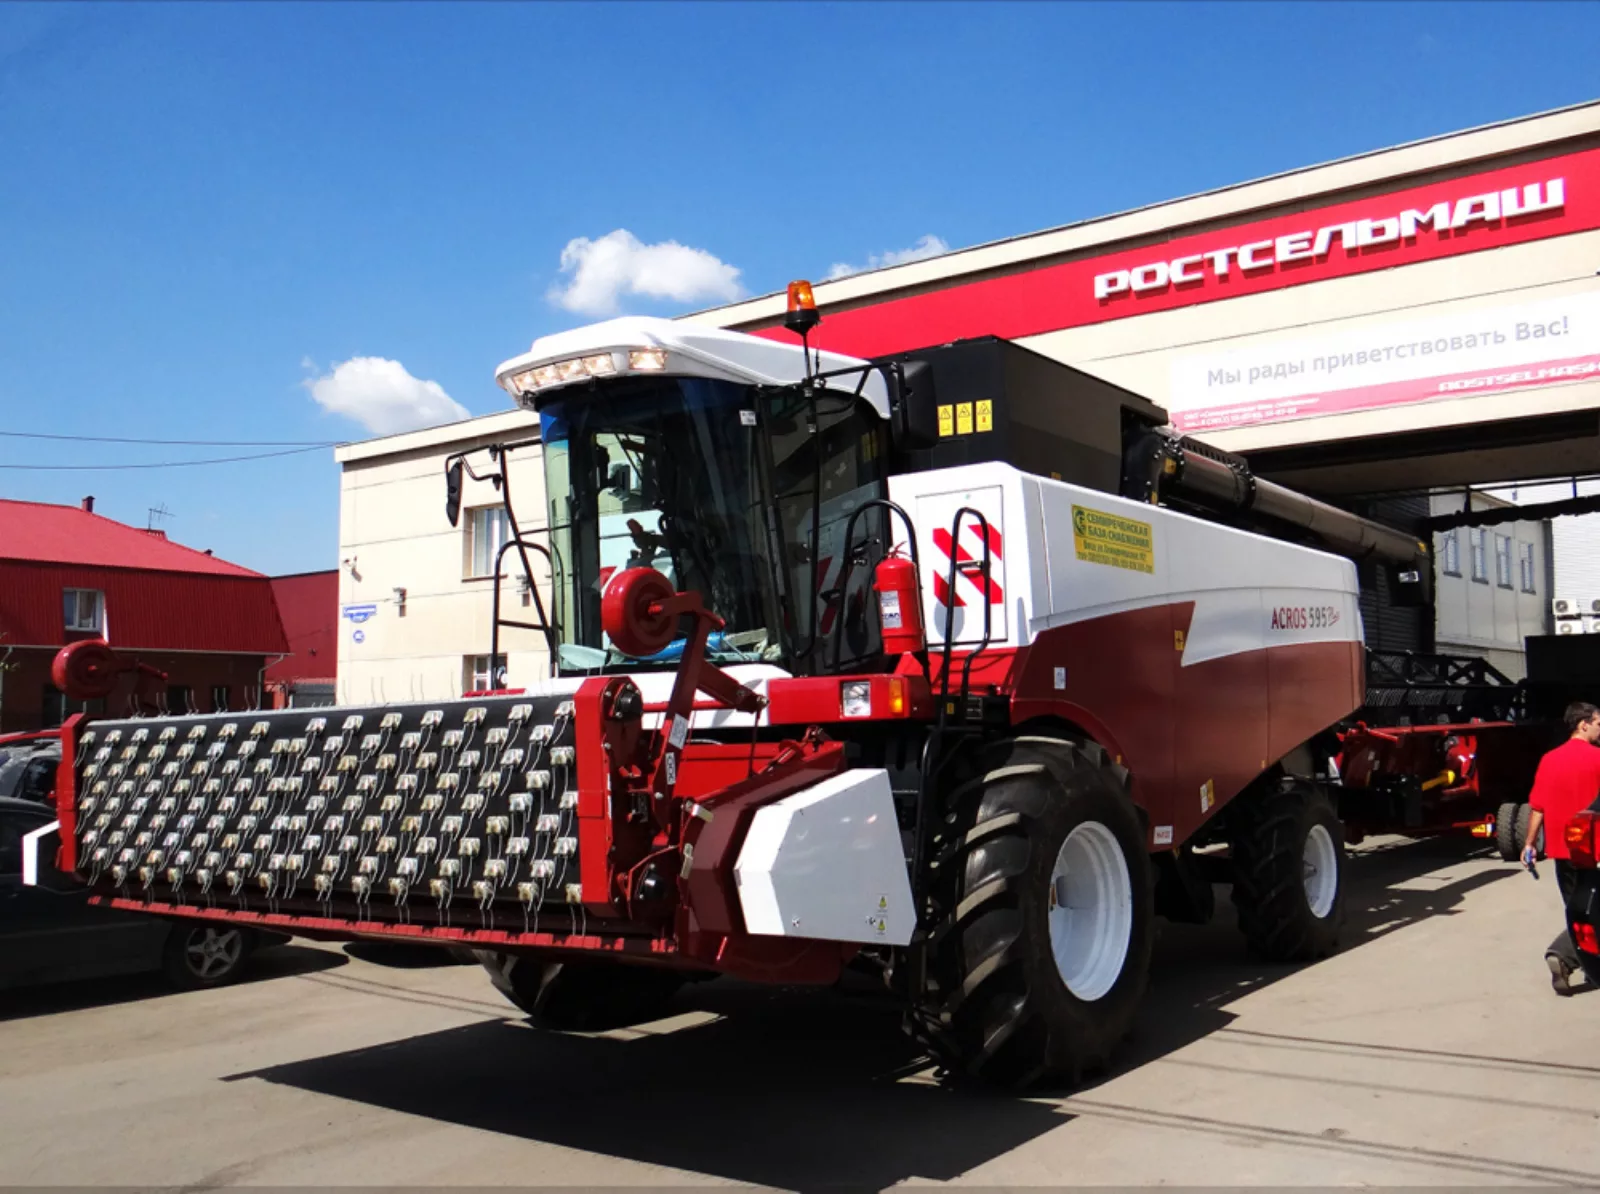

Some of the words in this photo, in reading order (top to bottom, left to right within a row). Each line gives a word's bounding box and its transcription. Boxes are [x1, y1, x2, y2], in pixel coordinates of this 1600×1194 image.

[1094, 177, 1565, 299] РОСТСЕЛЬМАШ
[1207, 368, 1241, 387] Мы
[1249, 360, 1306, 385] рады
[1313, 330, 1506, 374] приветствовать
[1515, 315, 1570, 342] Вас!
[1271, 606, 1307, 630] ACROS
[1309, 606, 1327, 629] 595
